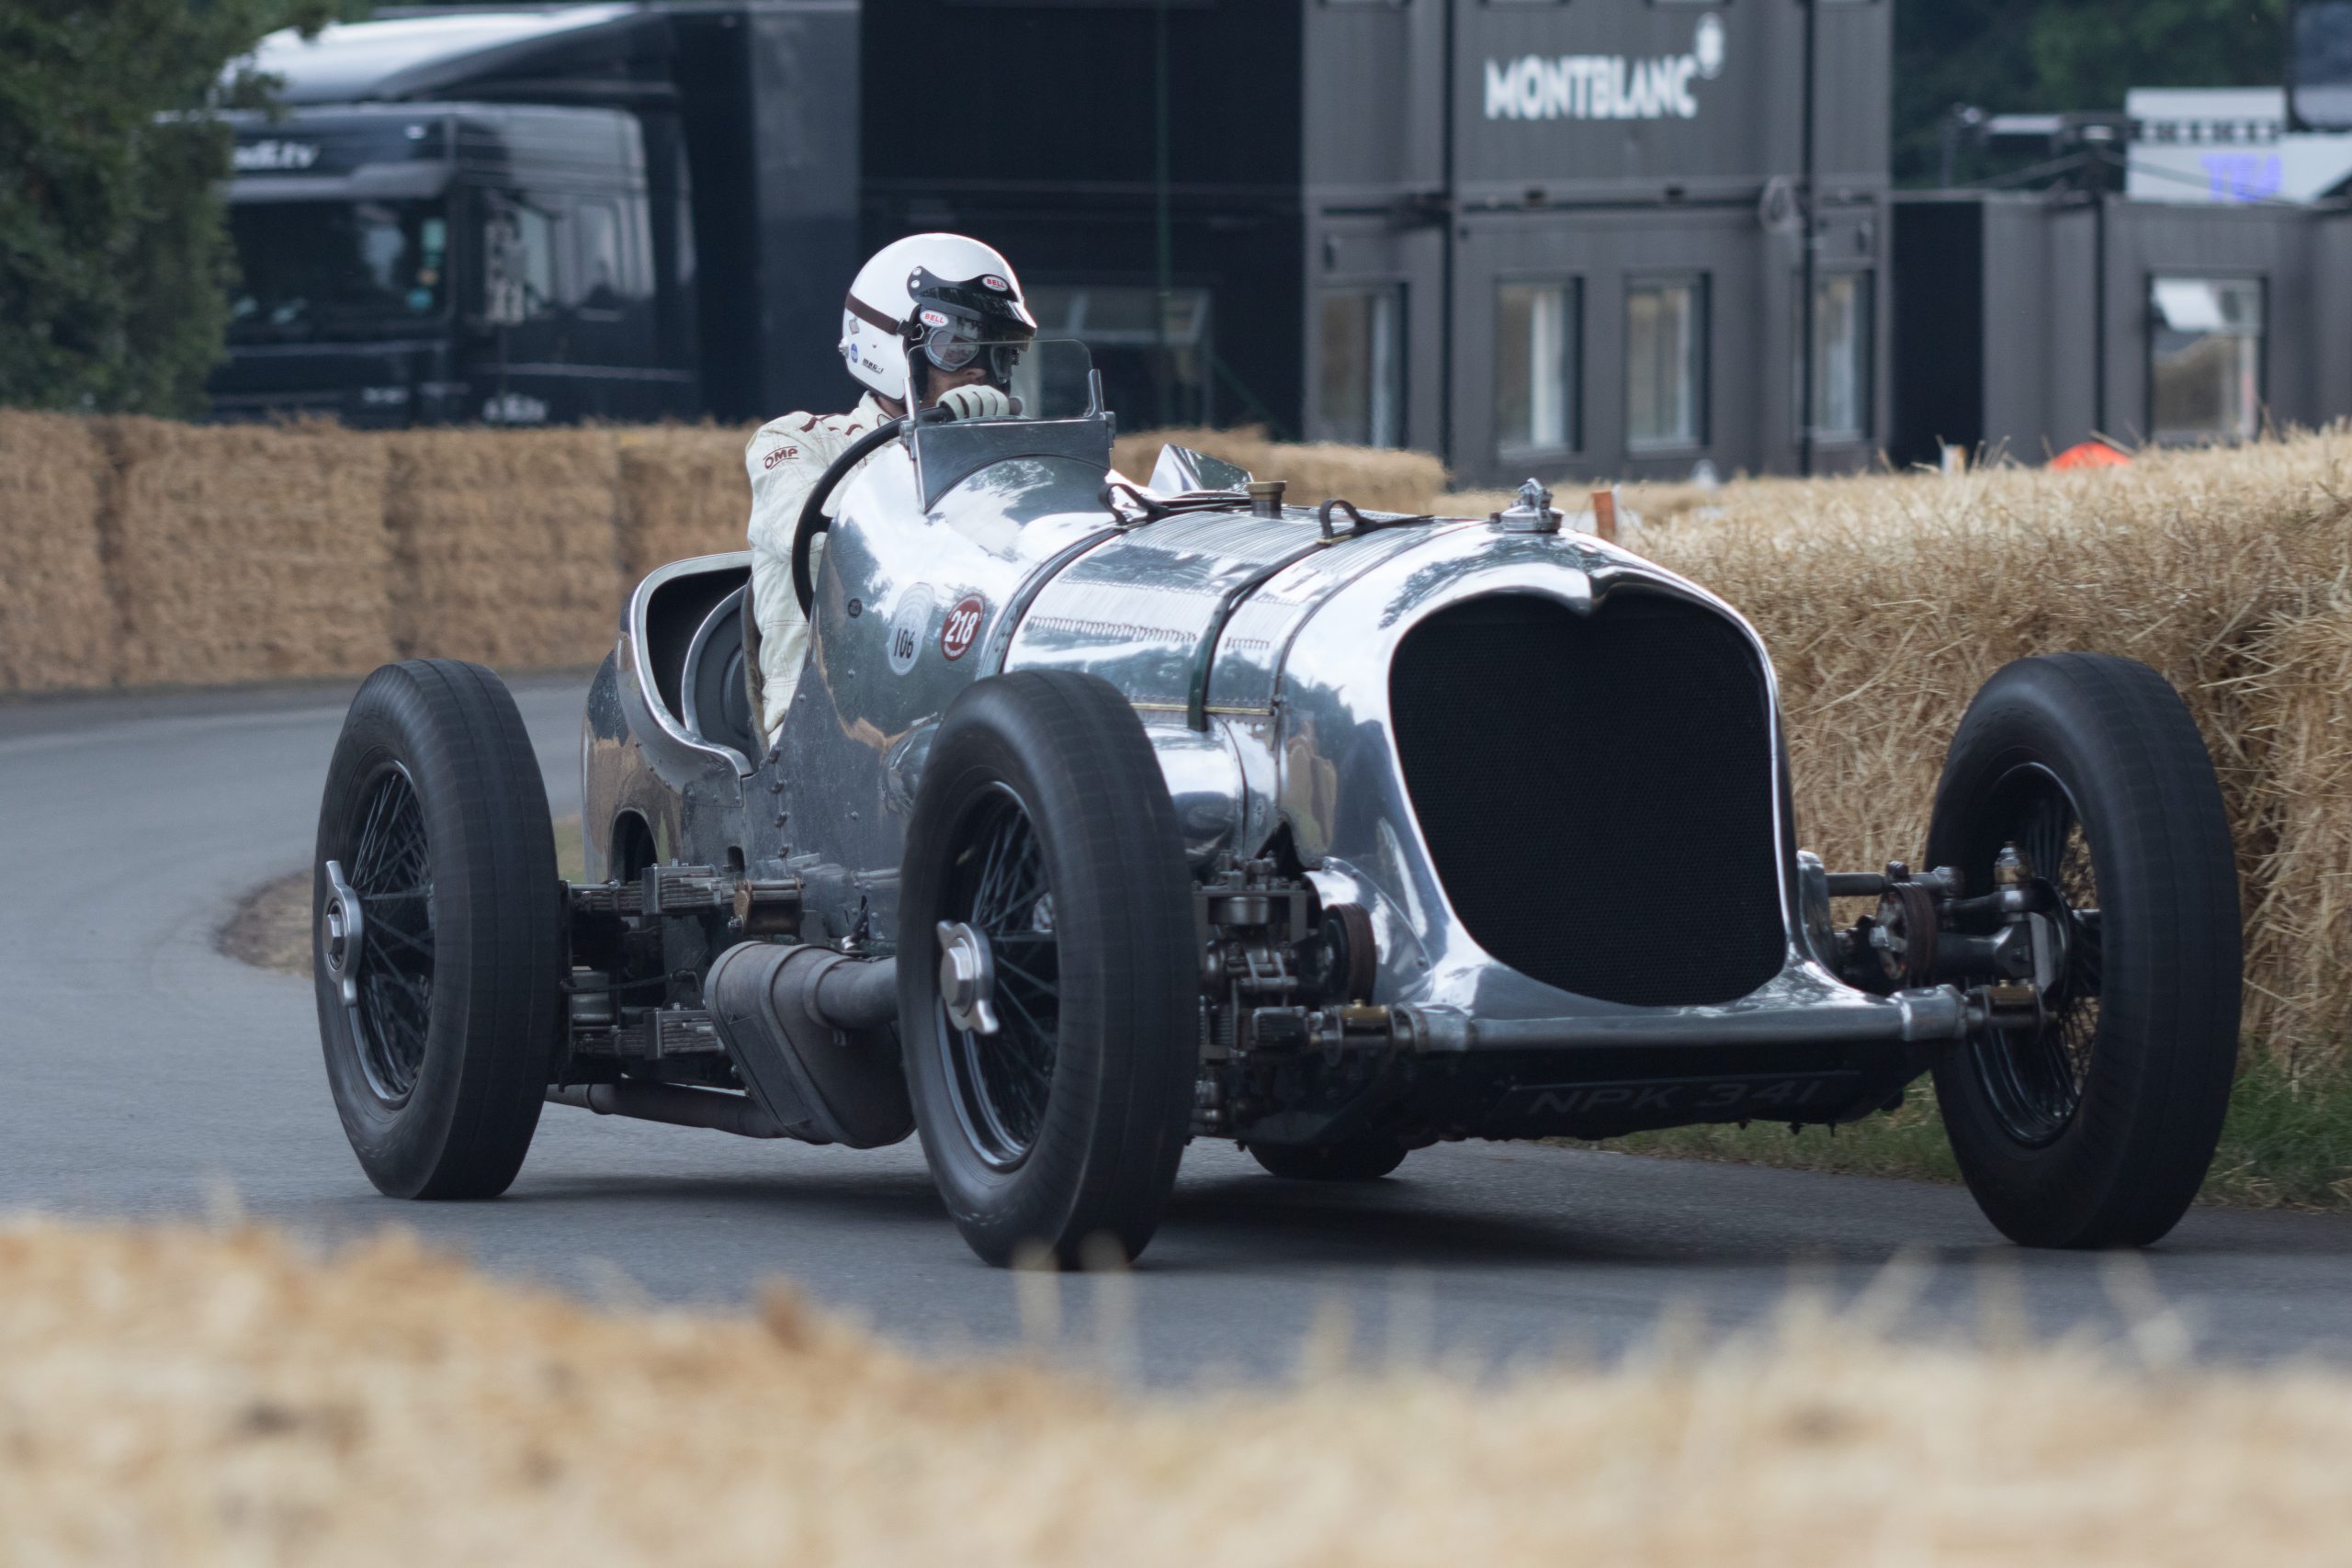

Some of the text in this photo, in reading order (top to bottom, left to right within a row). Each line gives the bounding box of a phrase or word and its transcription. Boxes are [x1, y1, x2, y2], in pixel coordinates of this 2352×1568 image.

[1485, 54, 1696, 119] MONTBLANC
[987, 279, 1005, 288] BELL
[924, 313, 944, 324] BELL
[764, 447, 798, 469] OMP
[893, 627, 915, 660] 106
[944, 610, 979, 645] 218
[1528, 1079, 1824, 1114] NPK 341
